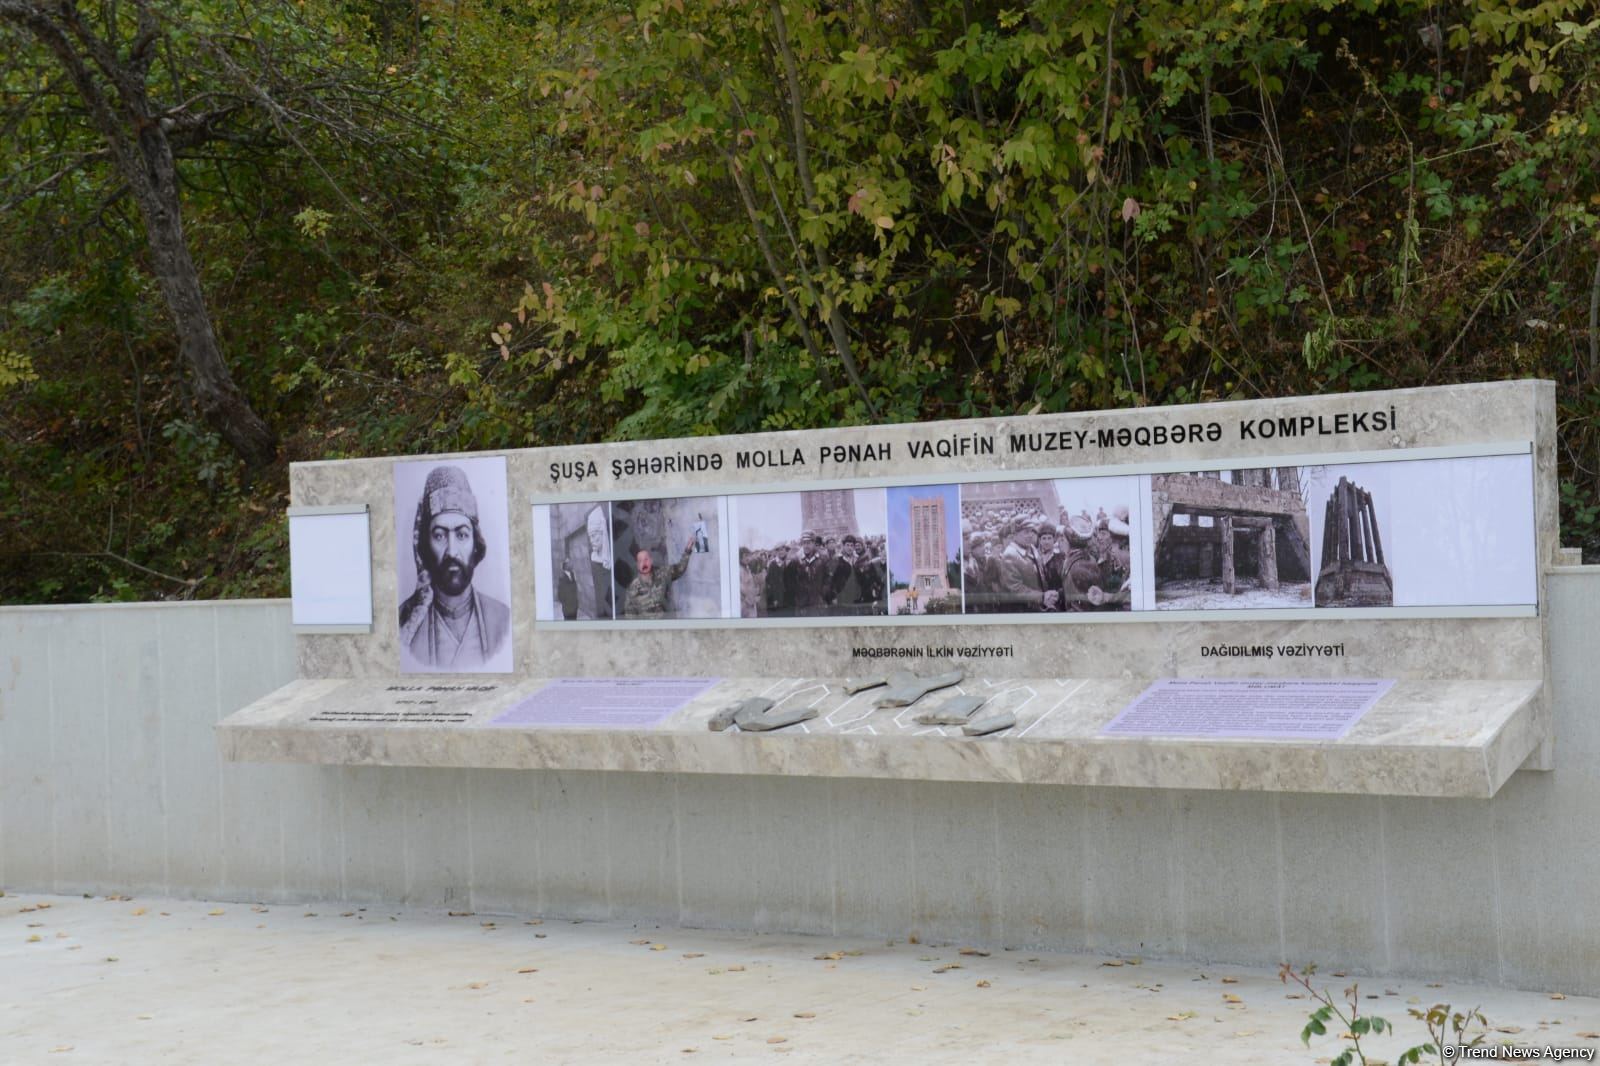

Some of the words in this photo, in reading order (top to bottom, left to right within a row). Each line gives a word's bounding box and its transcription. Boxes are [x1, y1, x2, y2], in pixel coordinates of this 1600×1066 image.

[550, 461, 598, 483] ŞUŞA
[612, 451, 723, 480] ŞƏHƏRİNDƏ
[736, 448, 805, 469] MOLLA
[820, 443, 892, 464] PƏNAH
[907, 432, 994, 459] VAQİFİN
[1010, 422, 1222, 453] MUZEY-MƏQBƏRƏ
[1240, 406, 1397, 440] KOMPLEKSİ
[852, 644, 924, 658] MƏQBƏRƏNİN
[926, 644, 954, 658] İLKİN
[957, 644, 1014, 658] VƏZİYYƏTİ
[1201, 643, 1274, 659] DAĞIDILMIŞ
[1277, 643, 1345, 657] VƏZİYYƏTİ
